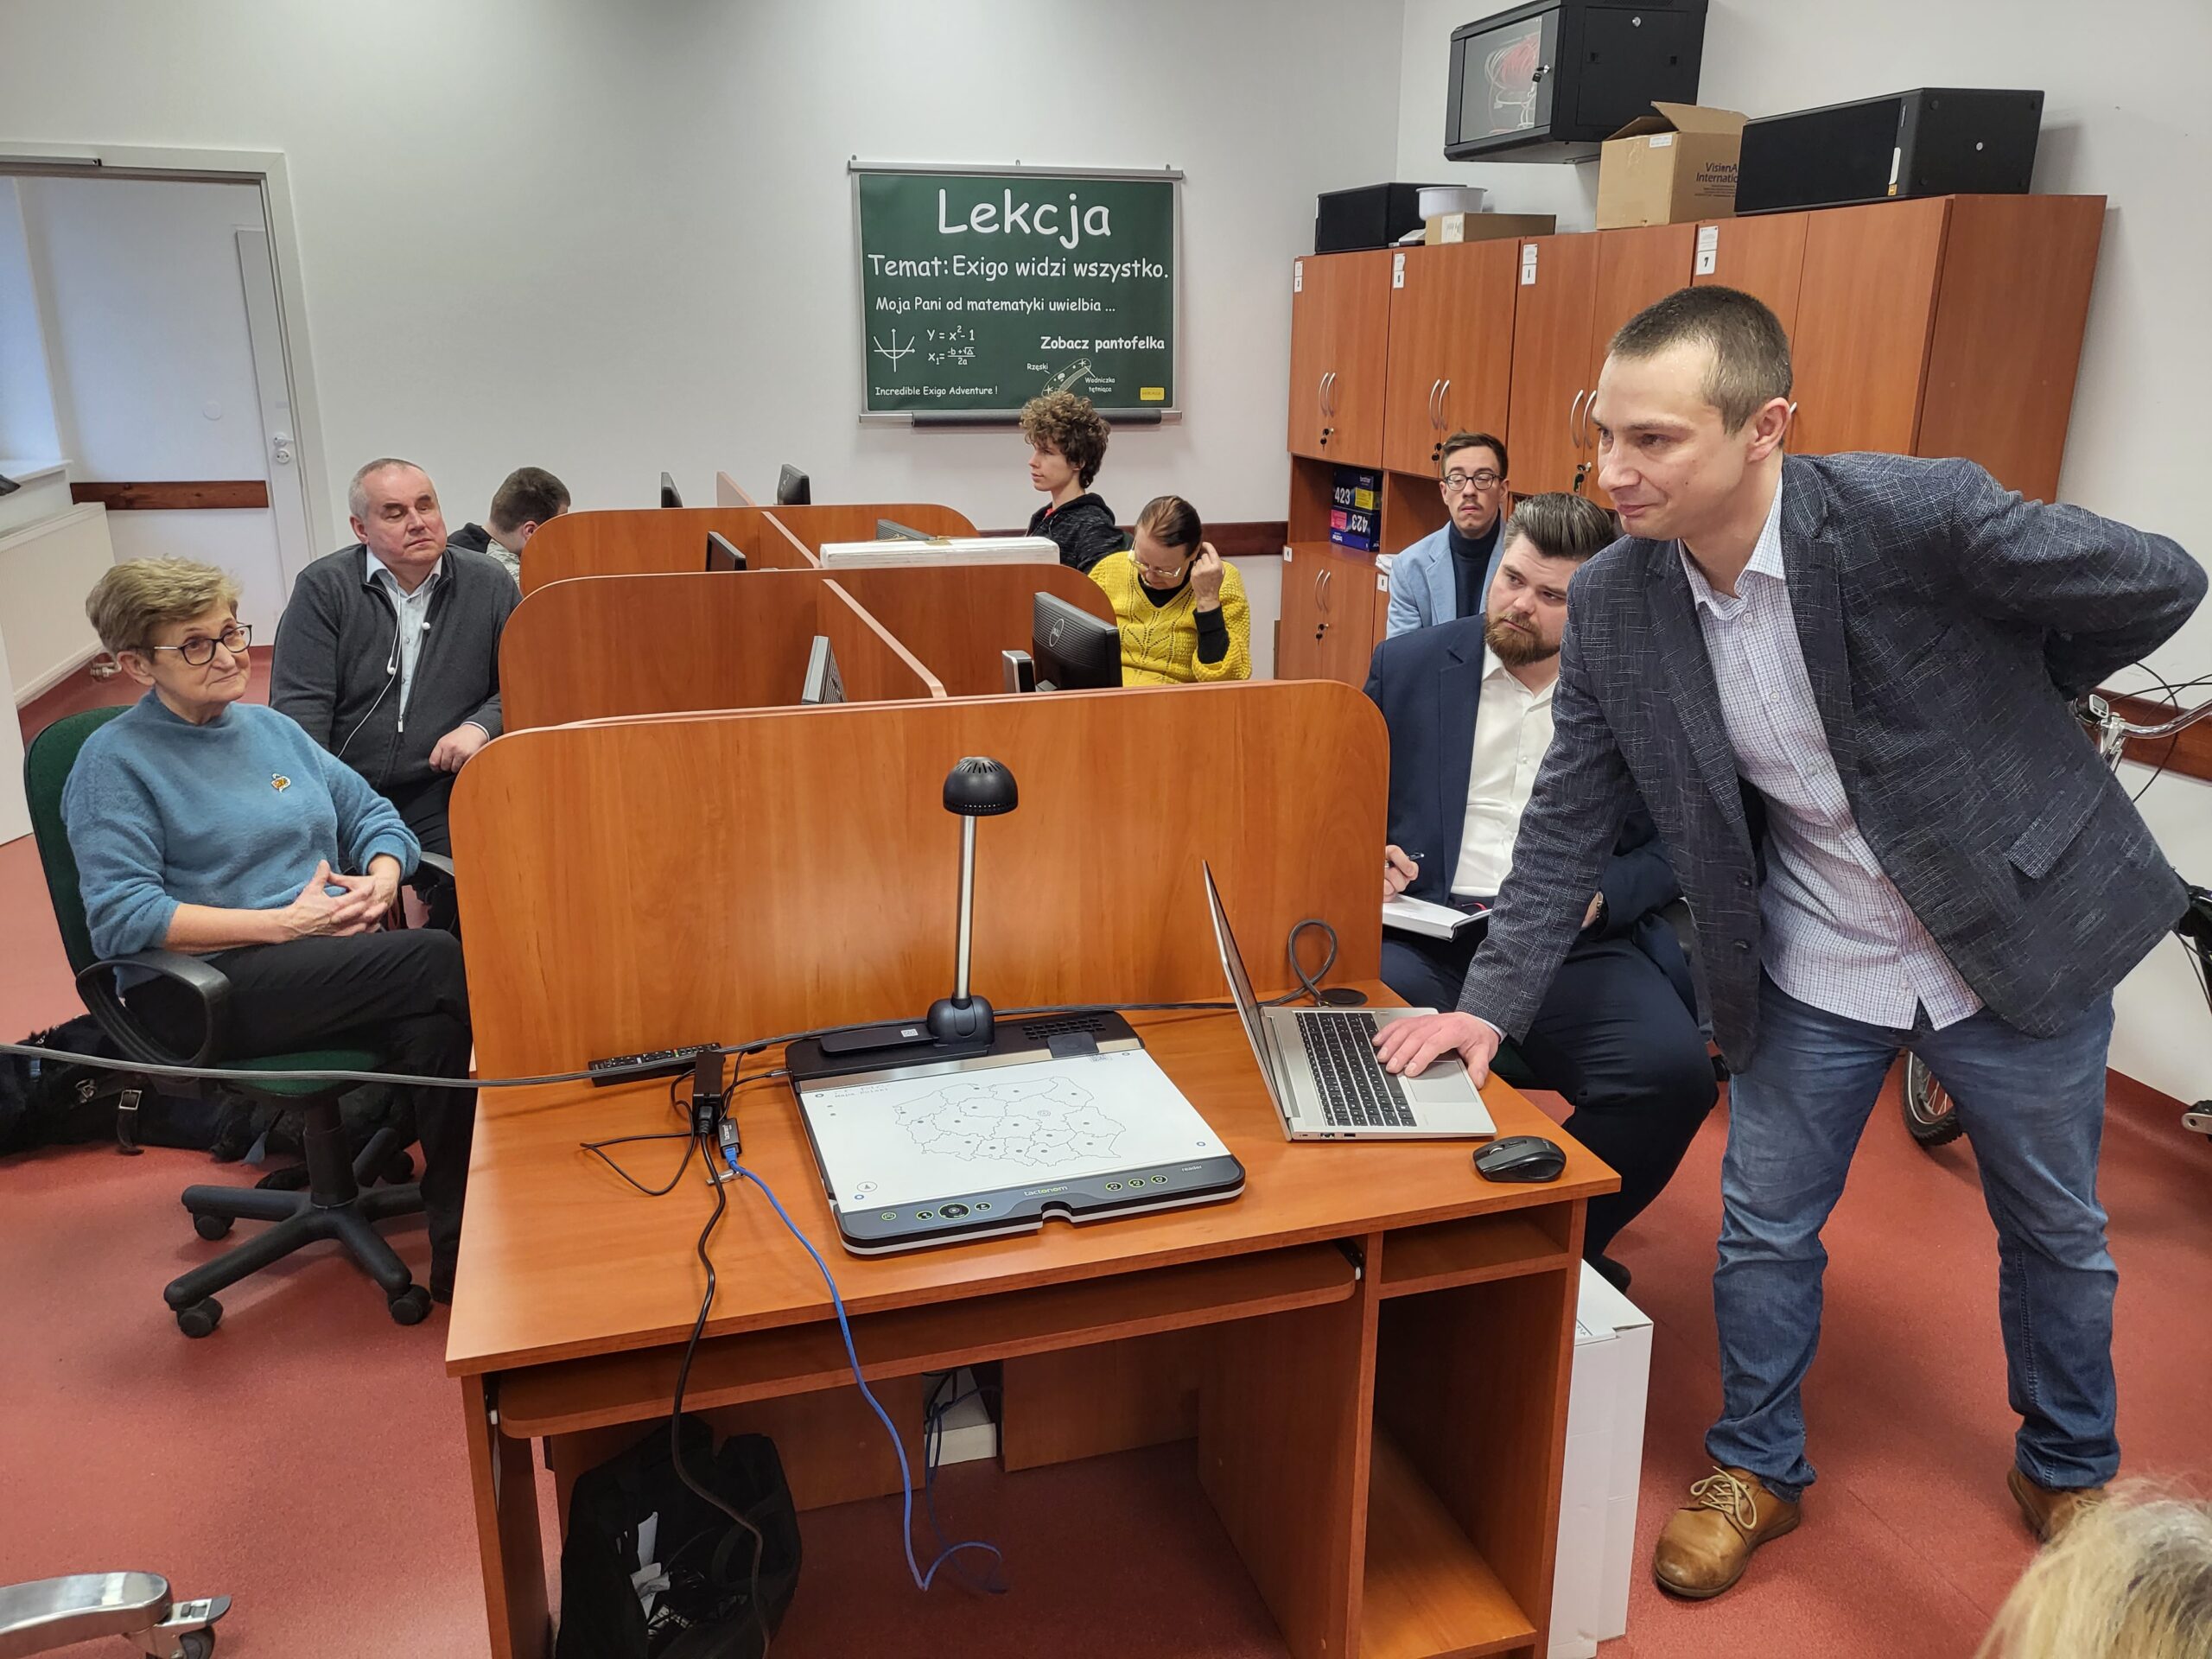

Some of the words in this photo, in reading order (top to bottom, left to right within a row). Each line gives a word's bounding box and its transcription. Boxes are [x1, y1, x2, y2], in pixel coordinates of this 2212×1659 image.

[938, 188, 1111, 250] Lekcja
[868, 254, 949, 277] Temat:
[952, 254, 1009, 282] Exigo
[1015, 256, 1066, 277] widzi
[1073, 257, 1169, 283] wszystko.
[875, 296, 911, 315] Moja
[914, 296, 942, 311] Pani
[946, 297, 963, 311] od
[967, 297, 1045, 315] matematyki
[1048, 297, 1102, 312] uwielbia
[1040, 336, 1090, 350] Zobacz
[1095, 335, 1166, 353] pantofelka
[874, 386, 921, 397] Incredible
[923, 386, 947, 397] Exigo
[949, 386, 994, 397] Adventure
[1334, 486, 1351, 505] 423
[1351, 513, 1369, 533] 423
[1023, 1185, 1068, 1197] tactonom
